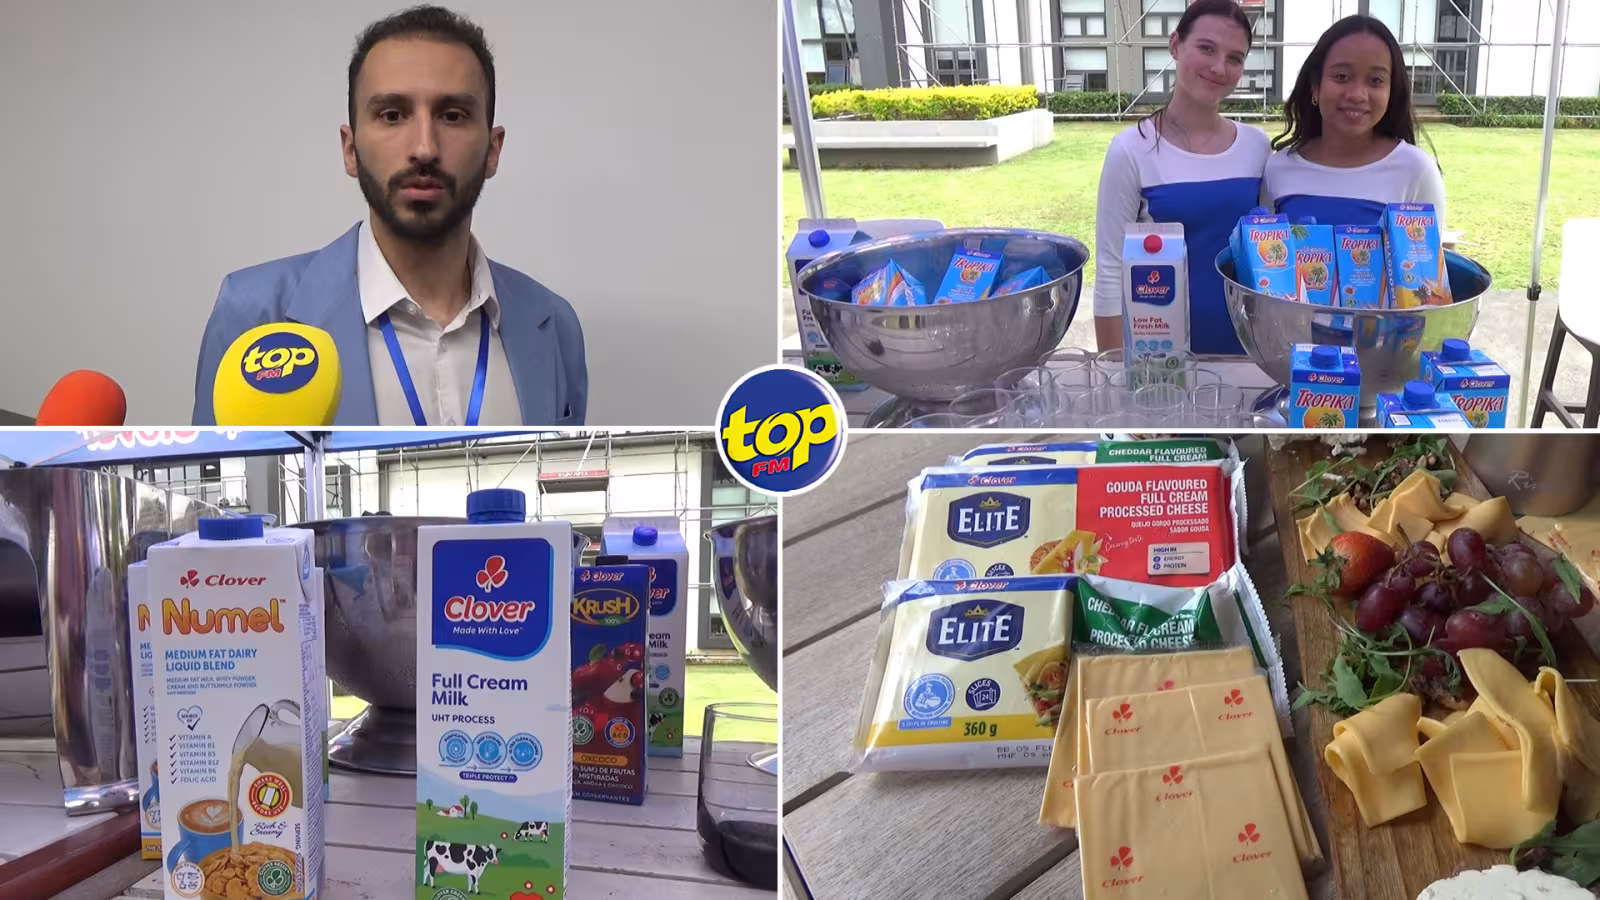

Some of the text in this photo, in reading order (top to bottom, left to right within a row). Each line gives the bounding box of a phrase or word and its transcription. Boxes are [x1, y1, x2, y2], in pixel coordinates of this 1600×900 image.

[1395, 214, 1434, 227] TROPIKA
[1250, 229, 1289, 242] TROPIKA
[1341, 236, 1380, 250] TROPIKA
[954, 257, 996, 272] TROPIKA
[1136, 285, 1170, 295] Clover
[244, 346, 315, 377] top
[256, 368, 281, 380] FM
[1317, 375, 1345, 383] Clover
[1469, 380, 1495, 388] Clover
[1296, 388, 1356, 410] TROPIKA
[1452, 394, 1505, 412] TROPIKA
[1154, 447, 1207, 455] FLAVOURED
[1174, 454, 1207, 462] CREAM
[980, 476, 1017, 485] Clover
[1106, 479, 1208, 493] GOUDA FLAVOURED
[1141, 491, 1208, 505] FULL CREAM
[1100, 503, 1208, 518] PROCESSED CHEESE
[958, 505, 1021, 533] ELITE
[1172, 518, 1209, 526] PROCESSADO
[205, 574, 267, 586] Clover
[591, 570, 625, 582] Clover
[968, 581, 1009, 591] Clover
[650, 588, 670, 599] ver
[444, 595, 536, 623] Clover
[573, 597, 631, 615] KRUSH
[162, 598, 285, 635] Numel
[938, 615, 1012, 645] ELITE
[165, 649, 258, 660] MEDIUM FAT DAIRY
[166, 661, 235, 672] LIQUID BLEND
[432, 674, 528, 691] Full Cream
[968, 680, 992, 694] SLICES
[432, 691, 468, 706] Milk
[432, 714, 495, 724] UHT PROCESS
[1218, 712, 1254, 721] Clover
[964, 722, 997, 737] 360 g
[1104, 726, 1142, 736] Clover
[581, 755, 618, 764] OXICOCO
[610, 768, 636, 776] FRUTAS
[254, 777, 287, 791] SHAKE WELL
[1156, 791, 1193, 802] Clover
[252, 801, 271, 816] BEFORE
[254, 822, 277, 830] Rich
[250, 829, 283, 839] Creamy
[1232, 852, 1272, 863] Clover
[1102, 875, 1144, 888] Clover
